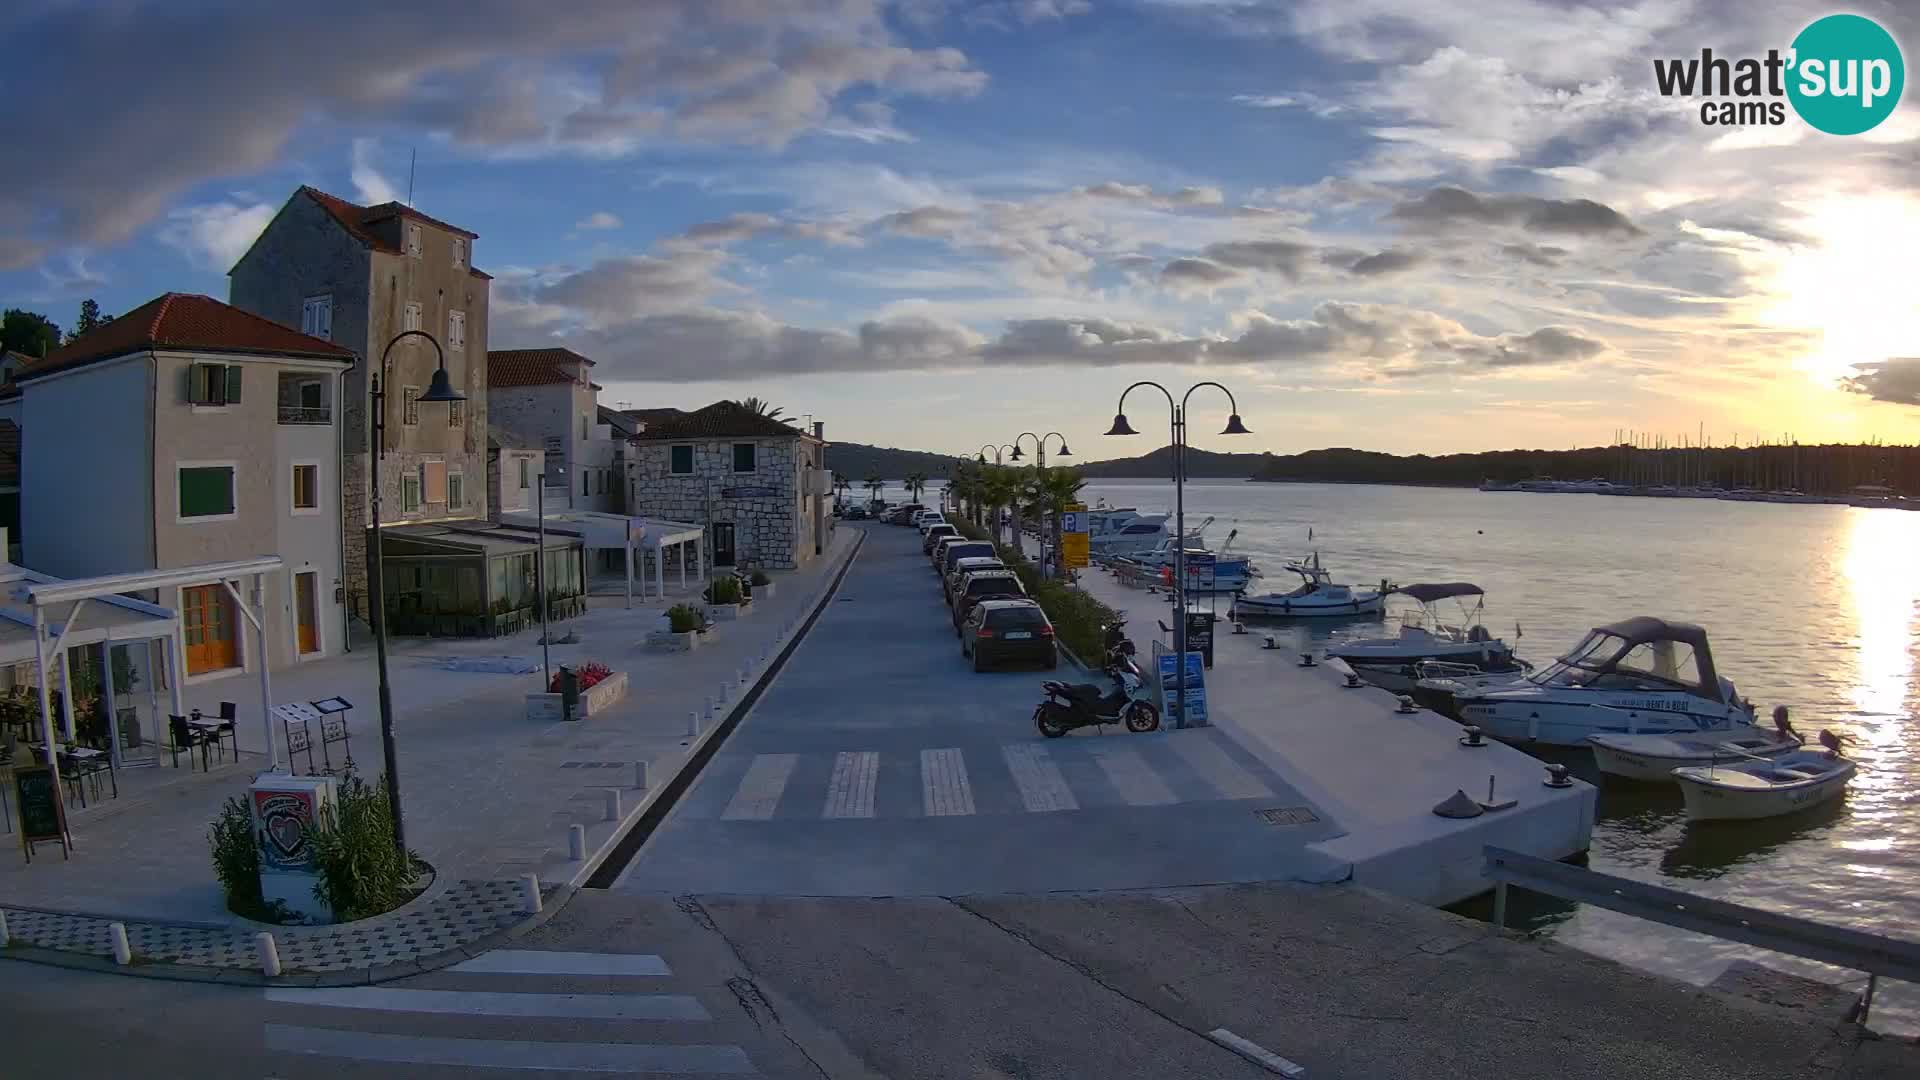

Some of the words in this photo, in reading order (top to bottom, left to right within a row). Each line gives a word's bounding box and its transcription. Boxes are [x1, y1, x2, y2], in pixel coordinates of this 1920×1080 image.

[1065, 514, 1075, 531] P
[1647, 700, 1664, 710] RENT
[1672, 701, 1689, 712] BOAT
